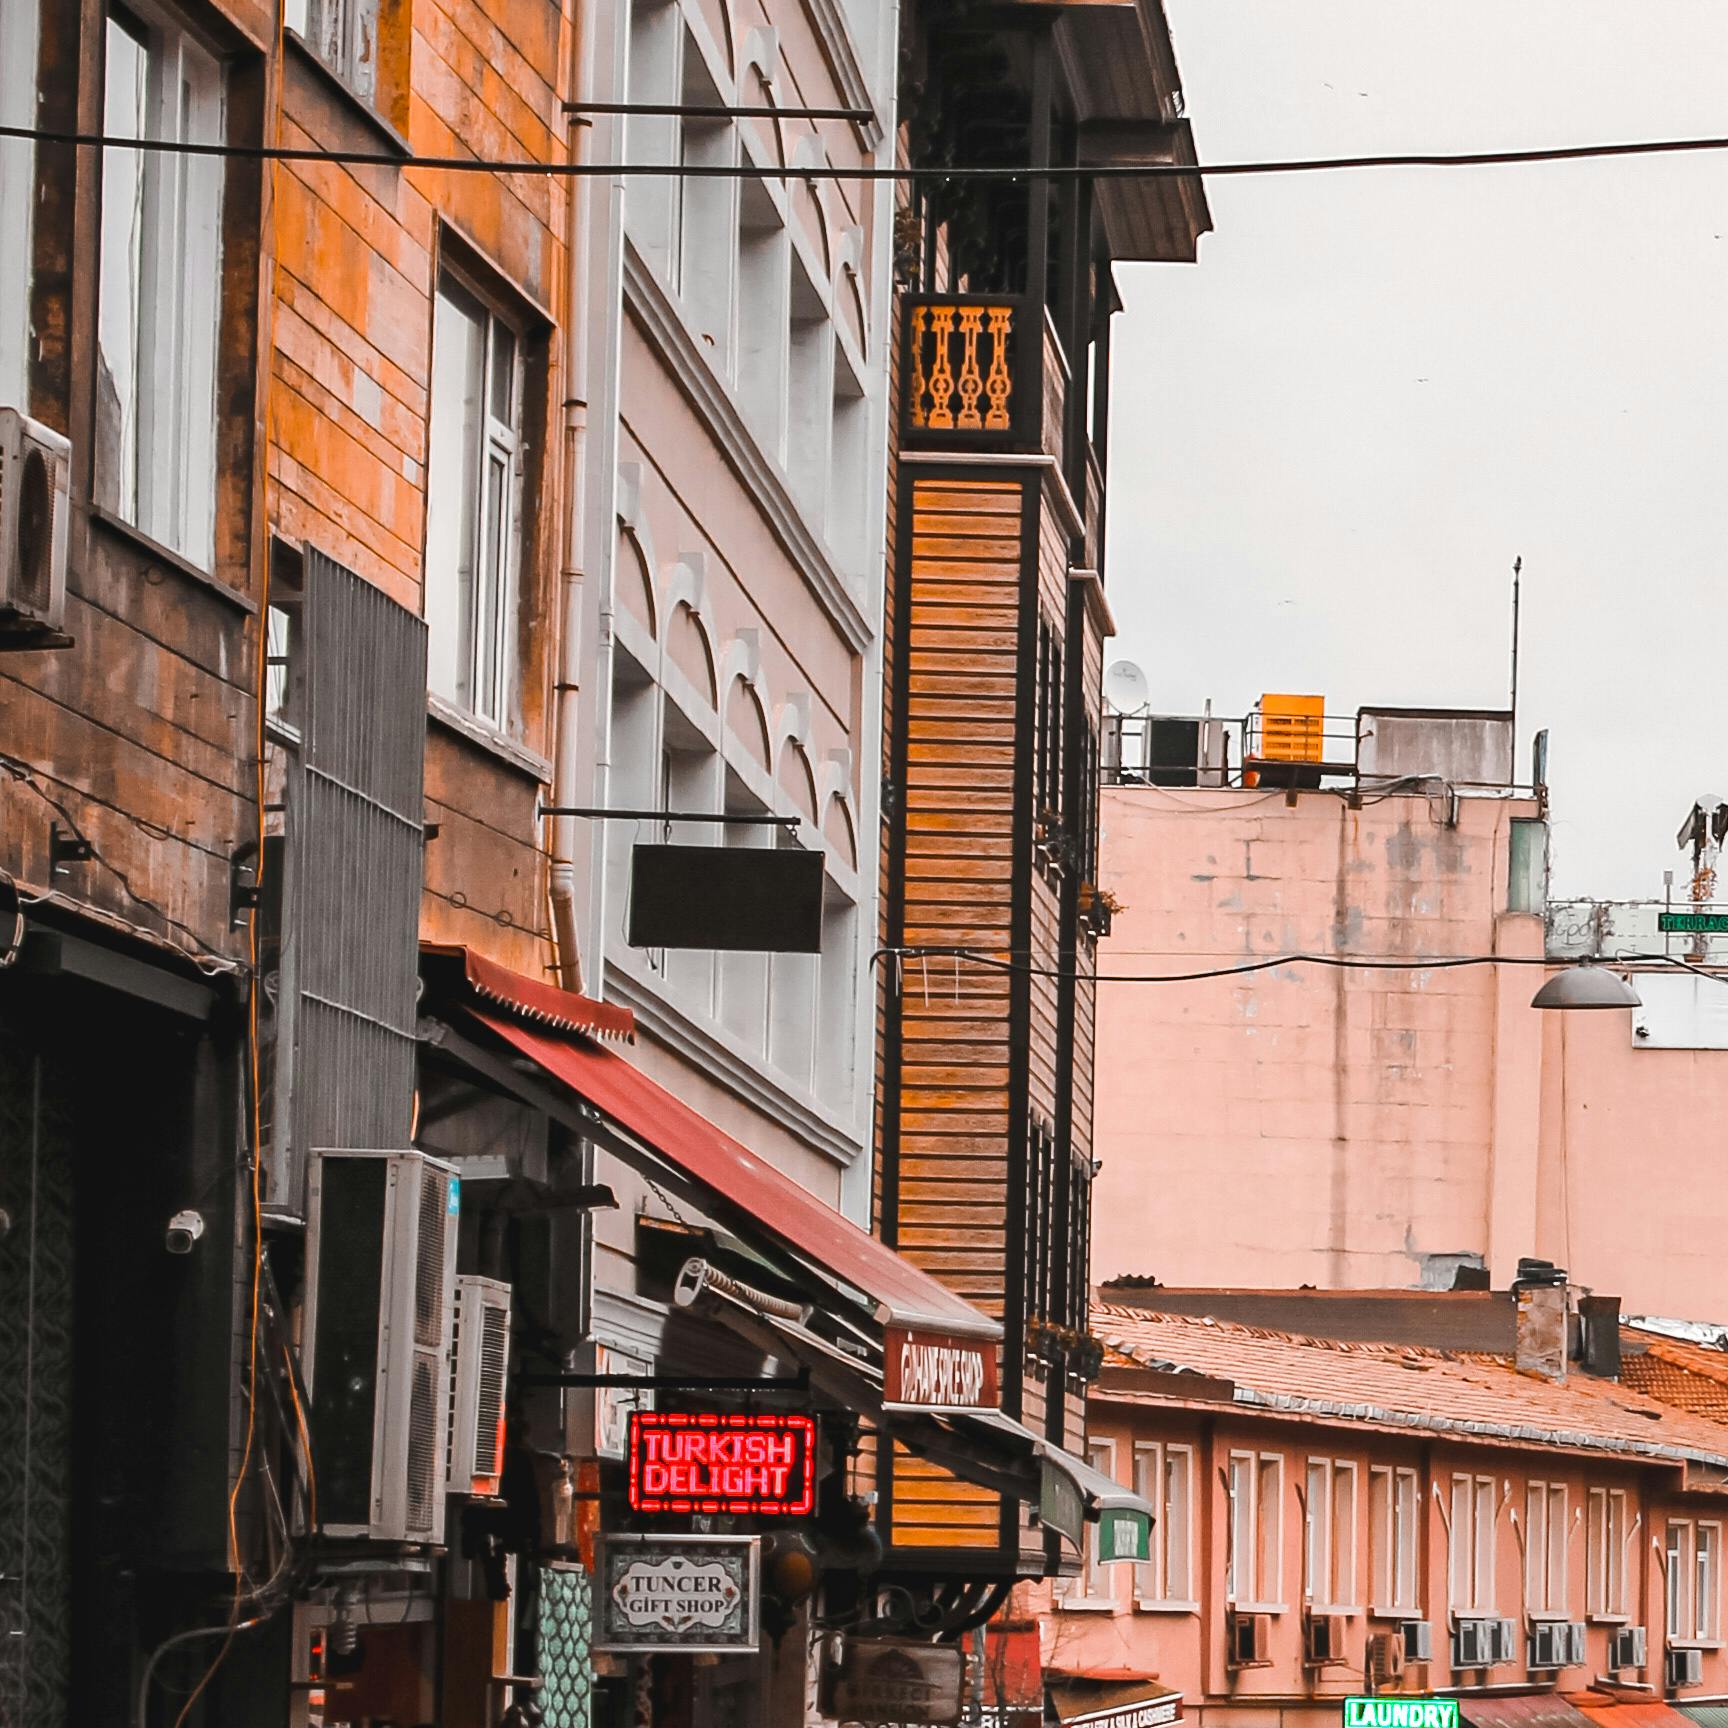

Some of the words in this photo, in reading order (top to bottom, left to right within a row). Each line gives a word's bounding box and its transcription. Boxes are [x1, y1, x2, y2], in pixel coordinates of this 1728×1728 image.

[643, 1432, 796, 1465] TURKISH
[643, 1465, 789, 1496] DELIGHT
[631, 1576, 722, 1593] TUNCER
[676, 1599, 725, 1614] SHOP
[1350, 1703, 1453, 1728] LAUNDRY
